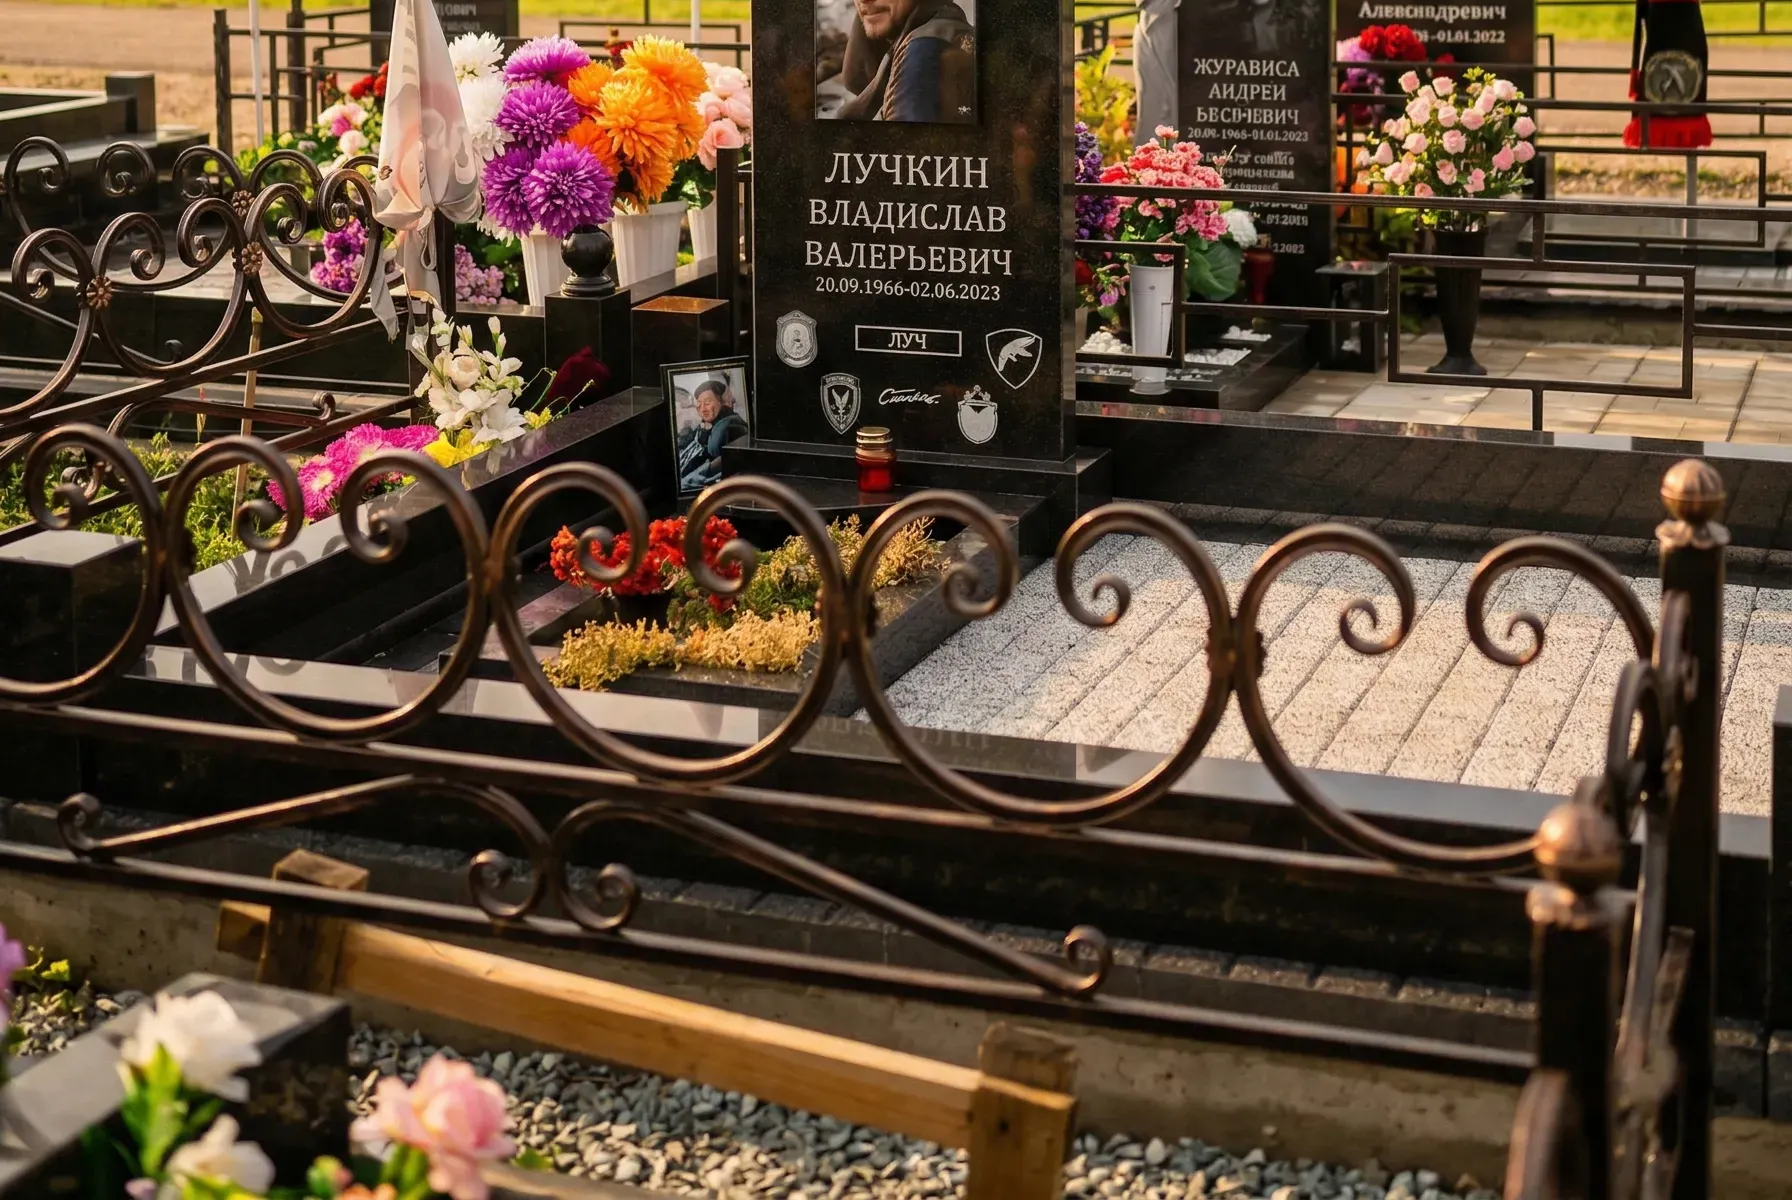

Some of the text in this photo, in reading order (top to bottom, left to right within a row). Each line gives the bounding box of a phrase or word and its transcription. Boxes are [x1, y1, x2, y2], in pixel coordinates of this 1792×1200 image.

[1194, 57, 1300, 77] ЖУРАВИСА
[825, 152, 989, 189] ЛУЧКИН
[809, 199, 1006, 233] ВЛАДИСЛАВ
[805, 240, 1012, 276] ВАЛЕРЬЕВИЧ
[816, 276, 1000, 301] 20.09.1966-02.06.2023
[888, 332, 927, 350] ЛУЧ
